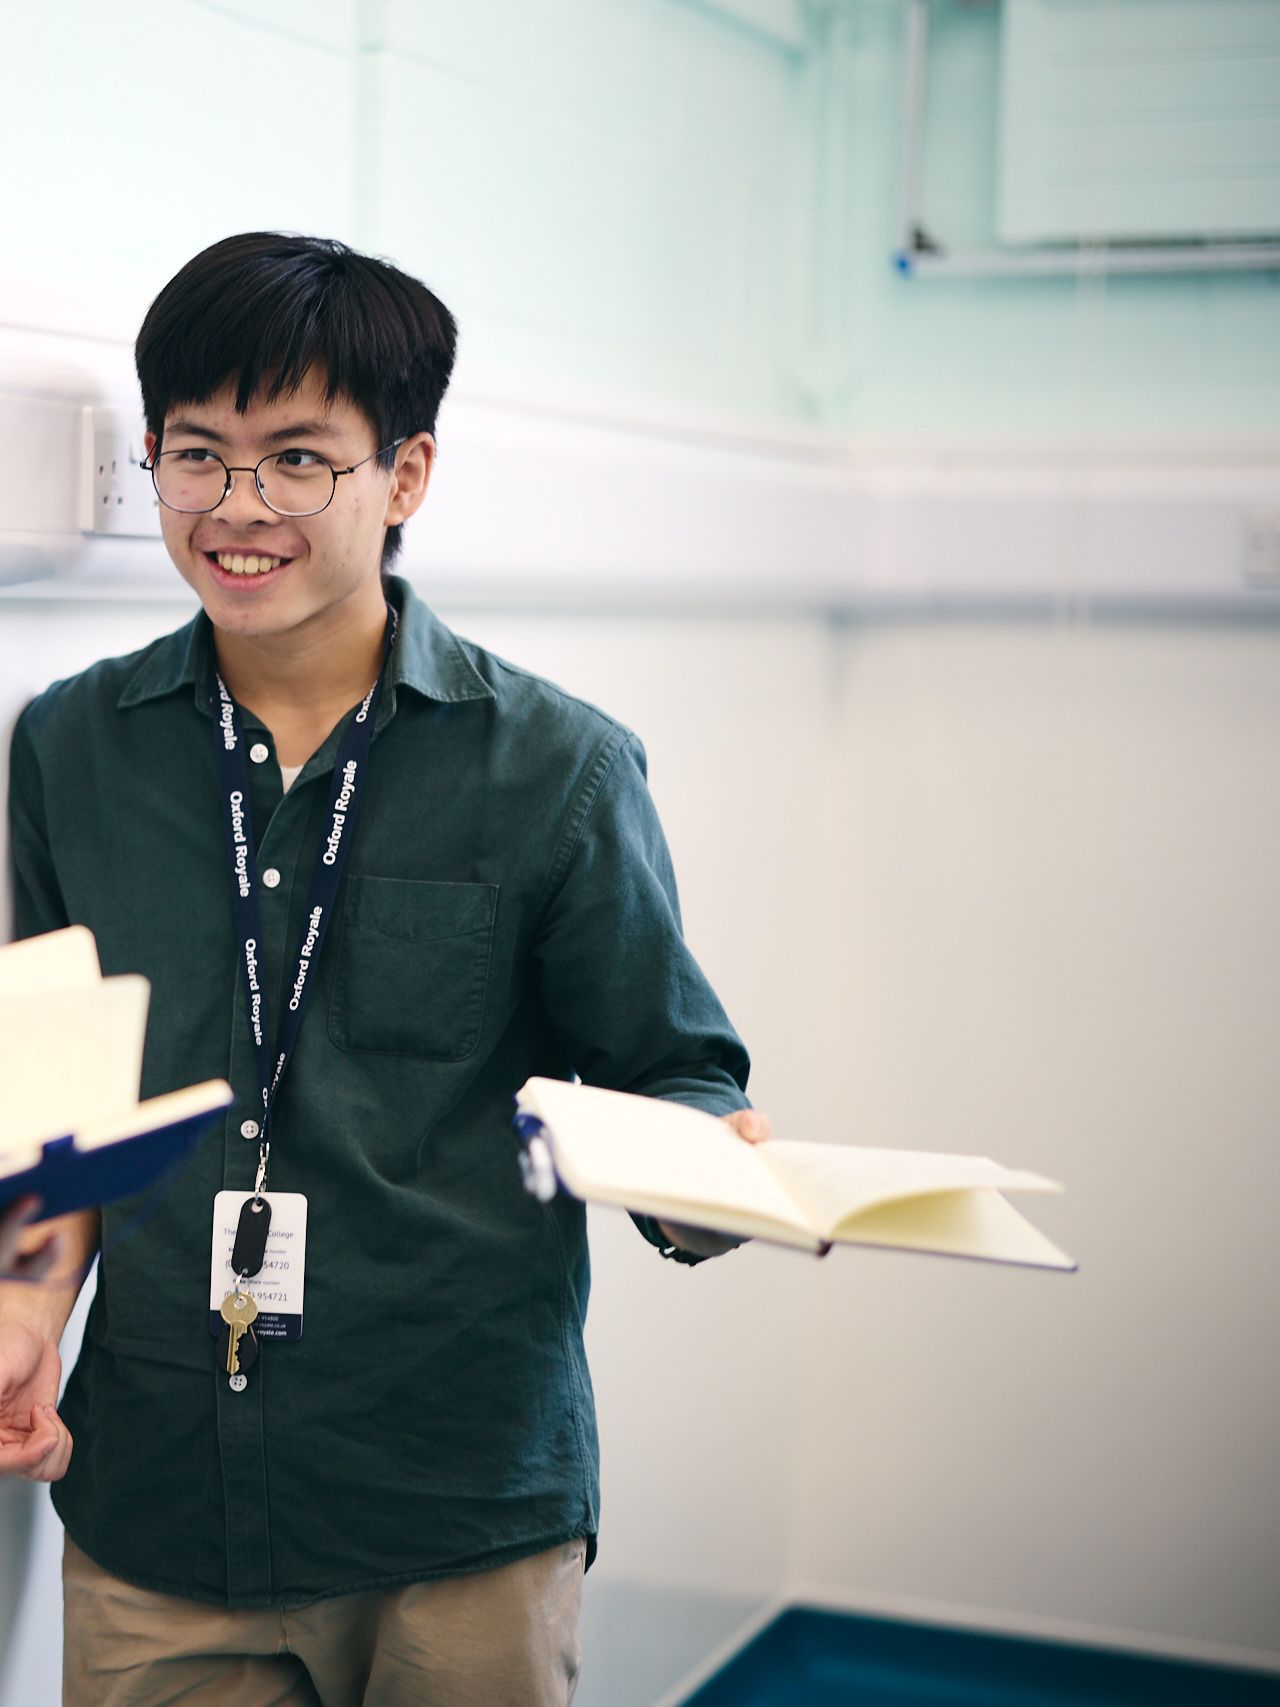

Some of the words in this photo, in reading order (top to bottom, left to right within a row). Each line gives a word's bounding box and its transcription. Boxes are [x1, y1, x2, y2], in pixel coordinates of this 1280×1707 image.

[220, 702, 238, 750] Royale
[334, 760, 357, 812] Royale
[230, 791, 246, 843] Oxford
[323, 813, 346, 865] Oxford
[234, 844, 251, 897] Royale
[245, 938, 260, 991] Oxford
[289, 959, 309, 1011] Oxford
[301, 905, 323, 957] Royale
[251, 993, 262, 1046] Royale
[268, 1231, 294, 1240] College
[263, 1260, 290, 1270] 54720
[257, 1292, 288, 1302] 954721
